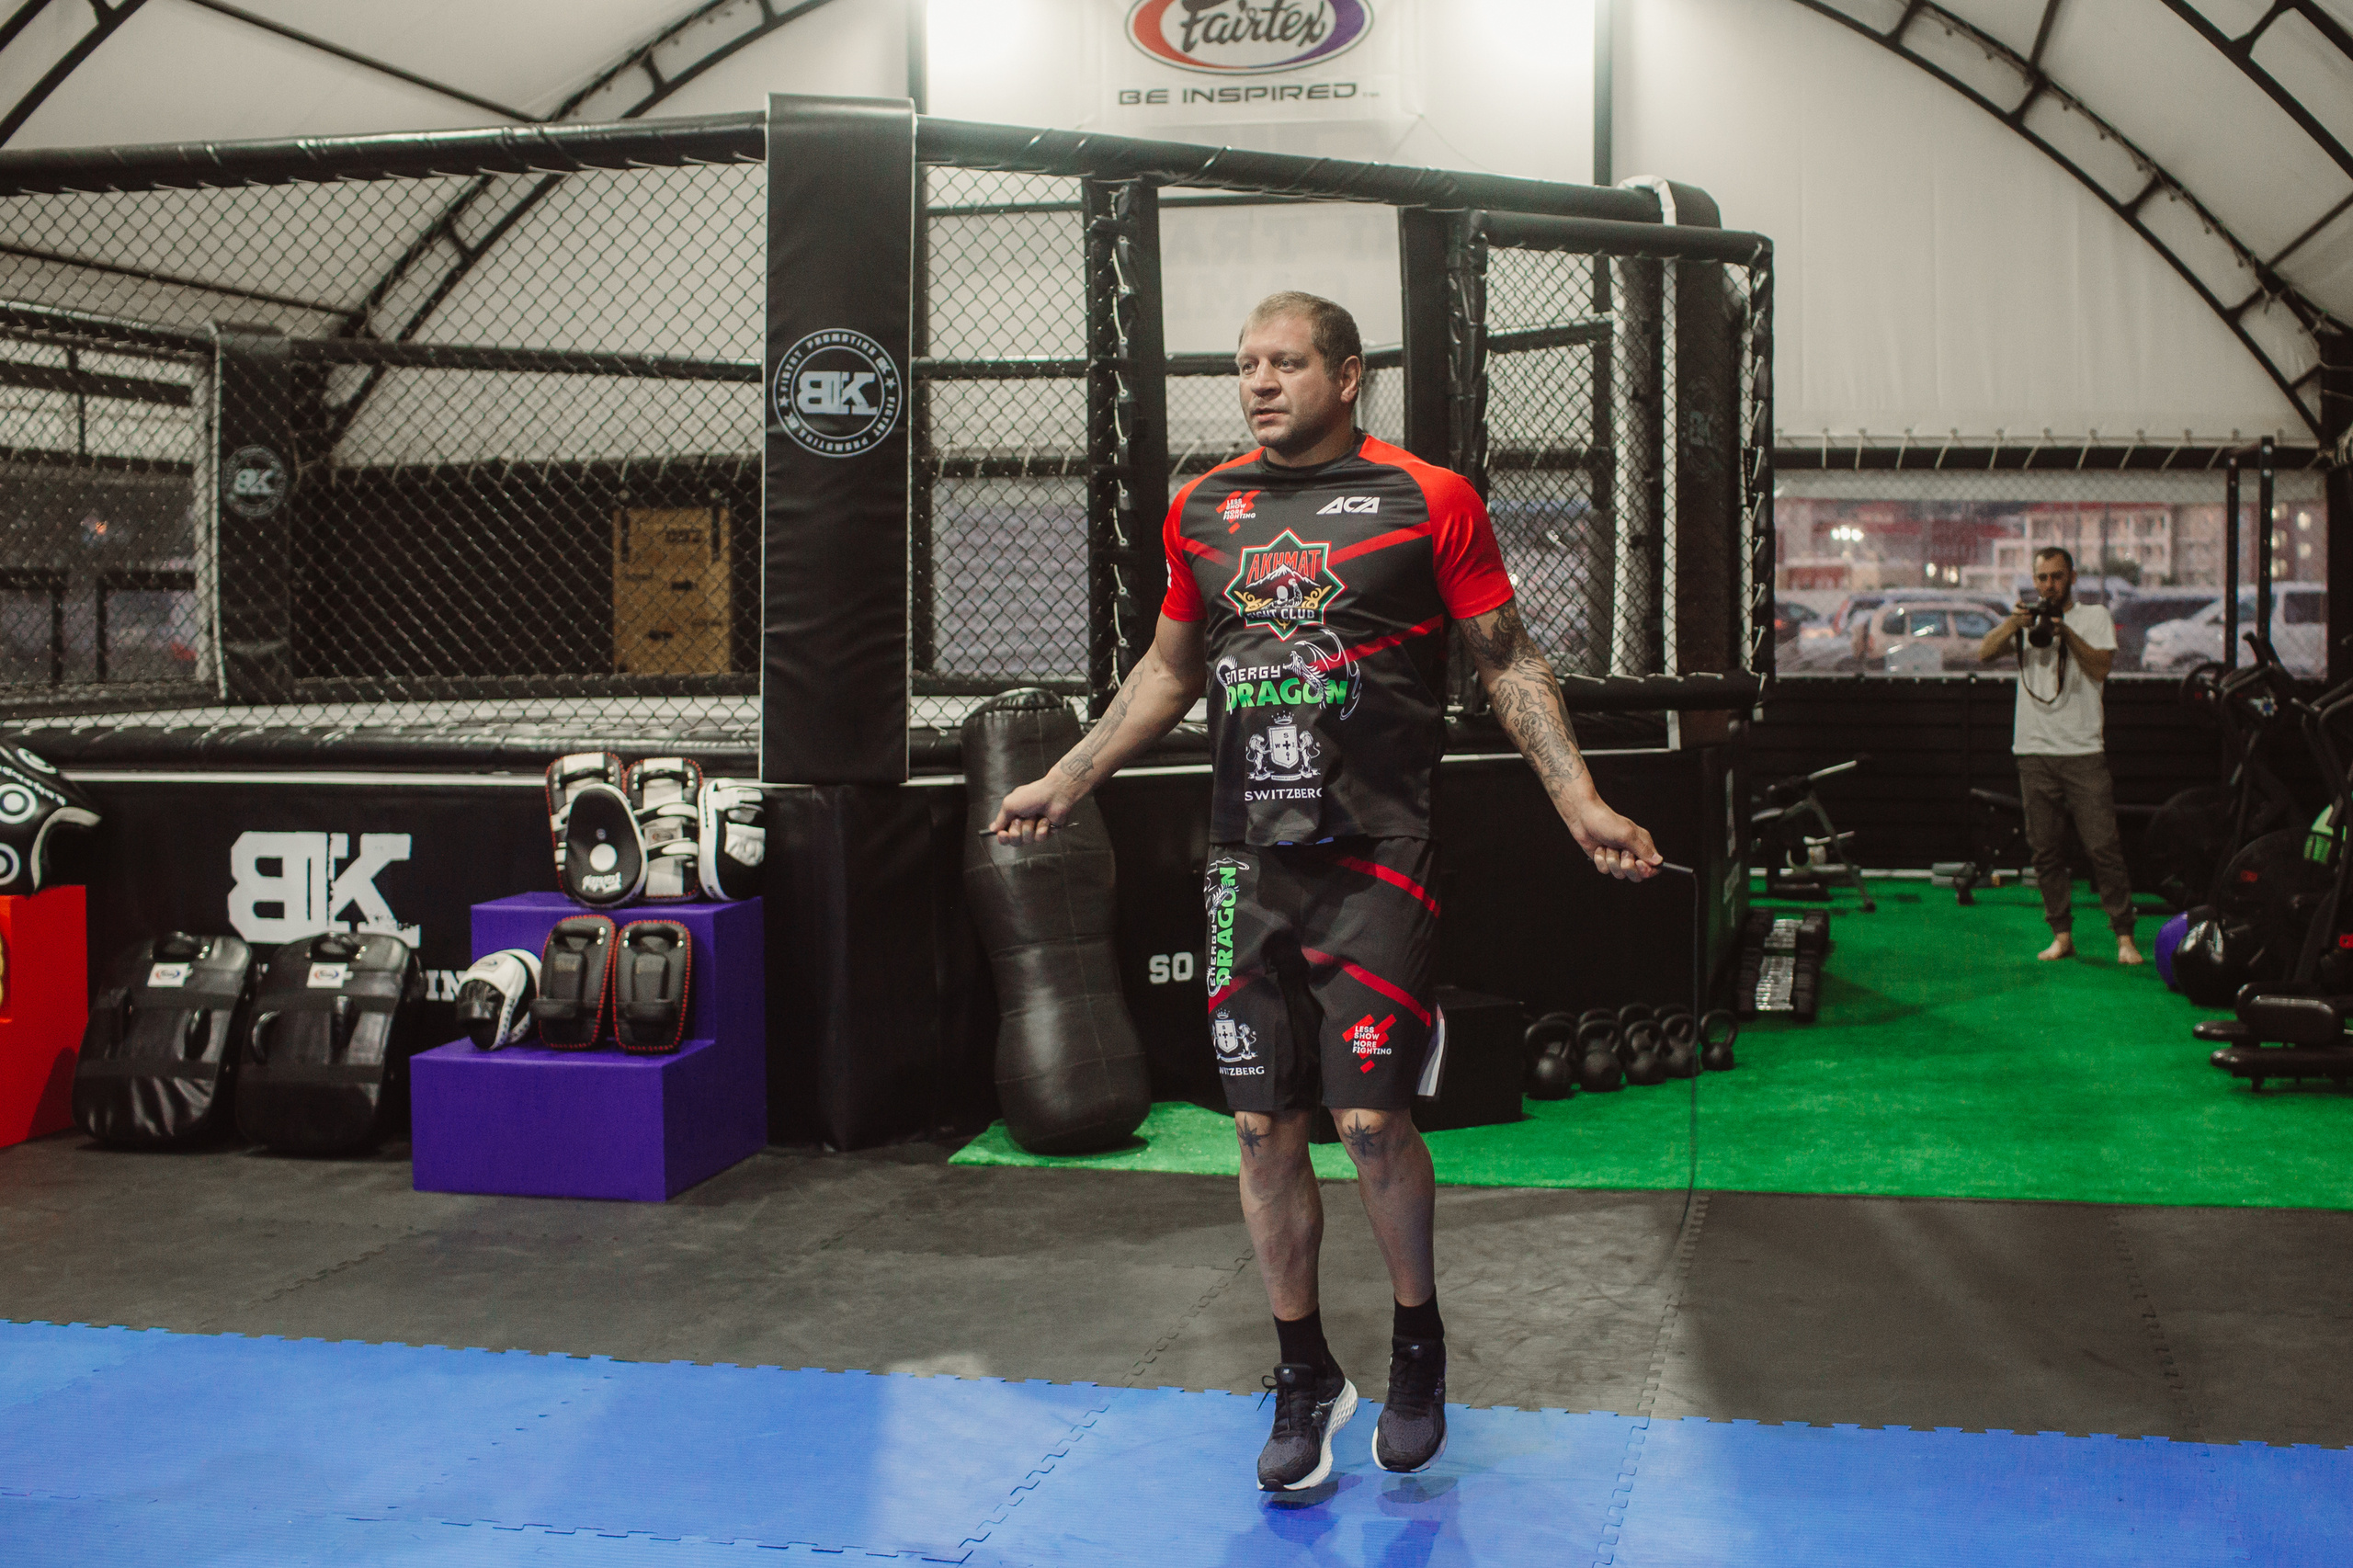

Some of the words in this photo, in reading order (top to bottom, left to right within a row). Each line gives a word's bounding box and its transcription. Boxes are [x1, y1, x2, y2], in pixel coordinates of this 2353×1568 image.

[1180, 0, 1326, 52] Fairtex
[1119, 89, 1168, 105] BE
[1183, 83, 1358, 103] INSPIRED
[797, 370, 878, 415] BK
[1316, 496, 1380, 515] ACA
[1245, 550, 1321, 586] AKHMAT
[1280, 608, 1315, 619] CLUB
[1226, 677, 1348, 712] DRAGON
[227, 831, 421, 949] BK
[1216, 867, 1237, 986] DRAGON
[1355, 1026, 1374, 1034] LESS
[1352, 1047, 1392, 1055] FIGHTING
[1353, 1040, 1377, 1048] MORE
[1219, 1066, 1265, 1076] WITZBERG
